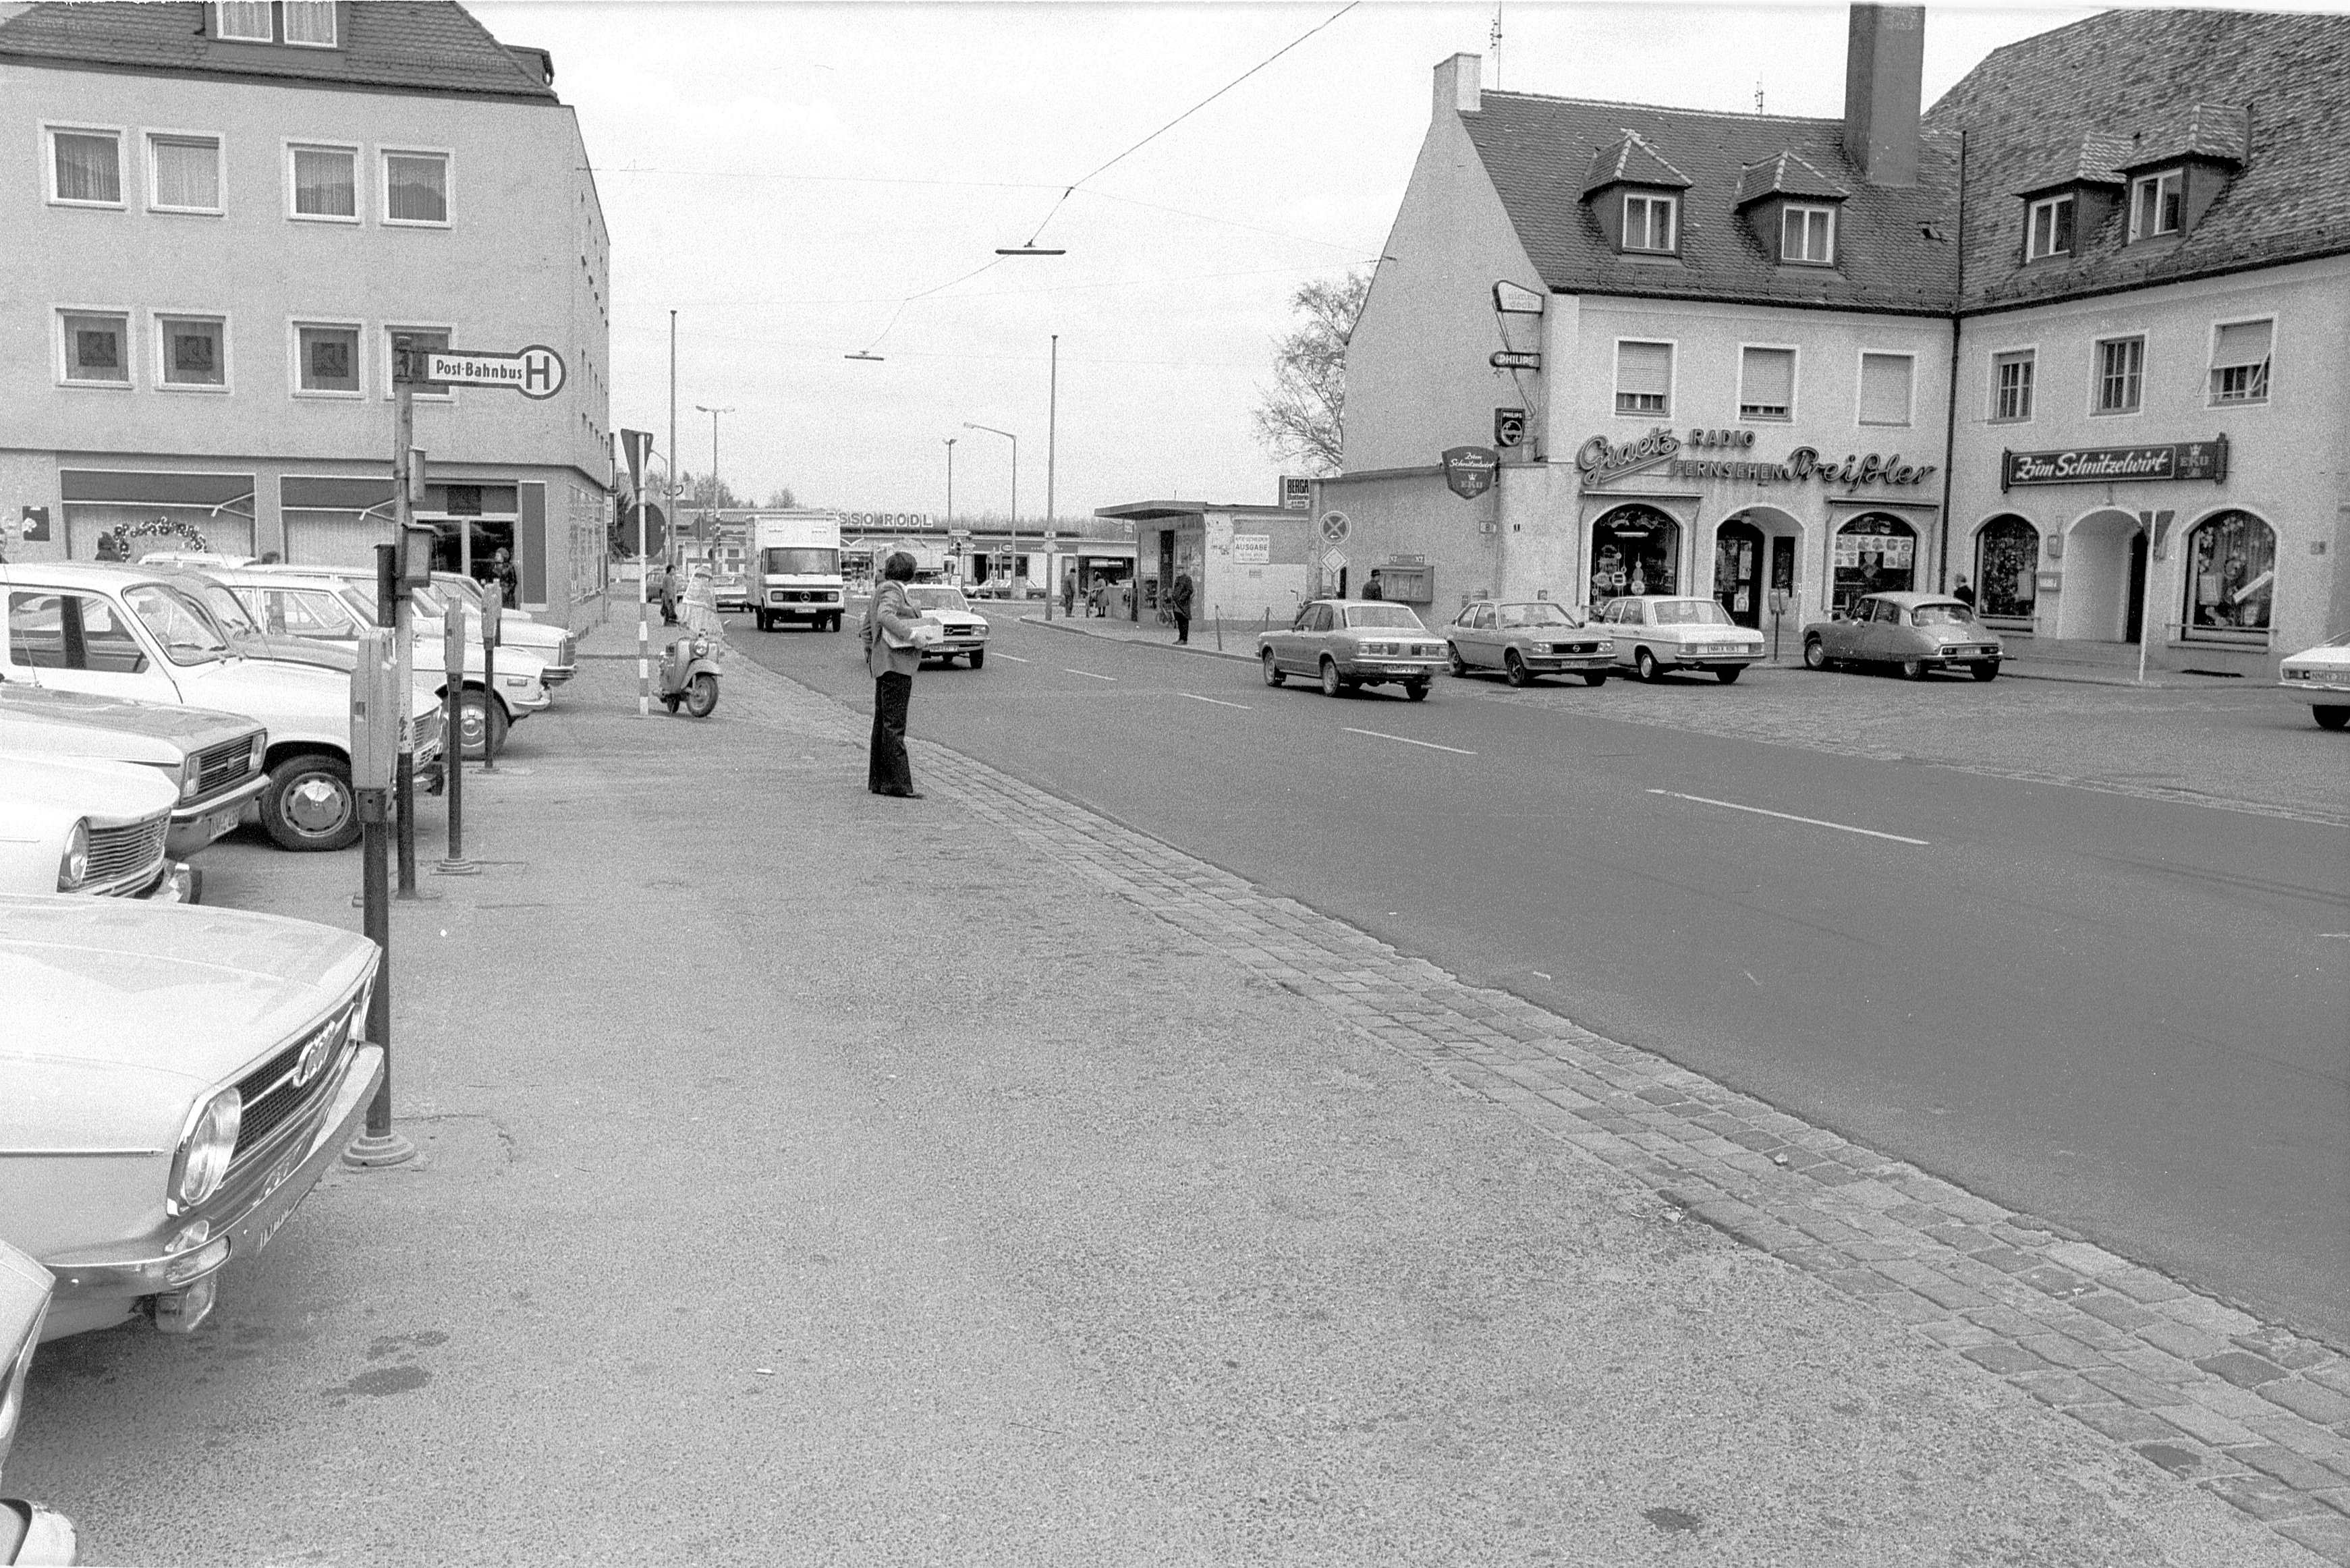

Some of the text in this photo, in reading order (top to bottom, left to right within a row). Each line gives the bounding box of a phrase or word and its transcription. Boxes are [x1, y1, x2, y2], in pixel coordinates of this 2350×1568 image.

[1499, 354, 1534, 365] PHILIPS
[435, 355, 551, 390] Post-Bahnbus H
[1689, 428, 1756, 448] RADIO
[1577, 427, 1681, 486] Graetz
[2056, 450, 2169, 476] Schnitzelwirt
[2179, 455, 2210, 467] EKU
[1673, 459, 1785, 480] FERNSEHEN
[1783, 445, 1938, 493] Preißler
[1287, 478, 1310, 494] BERGA
[1235, 543, 1268, 551] AUSGABE
